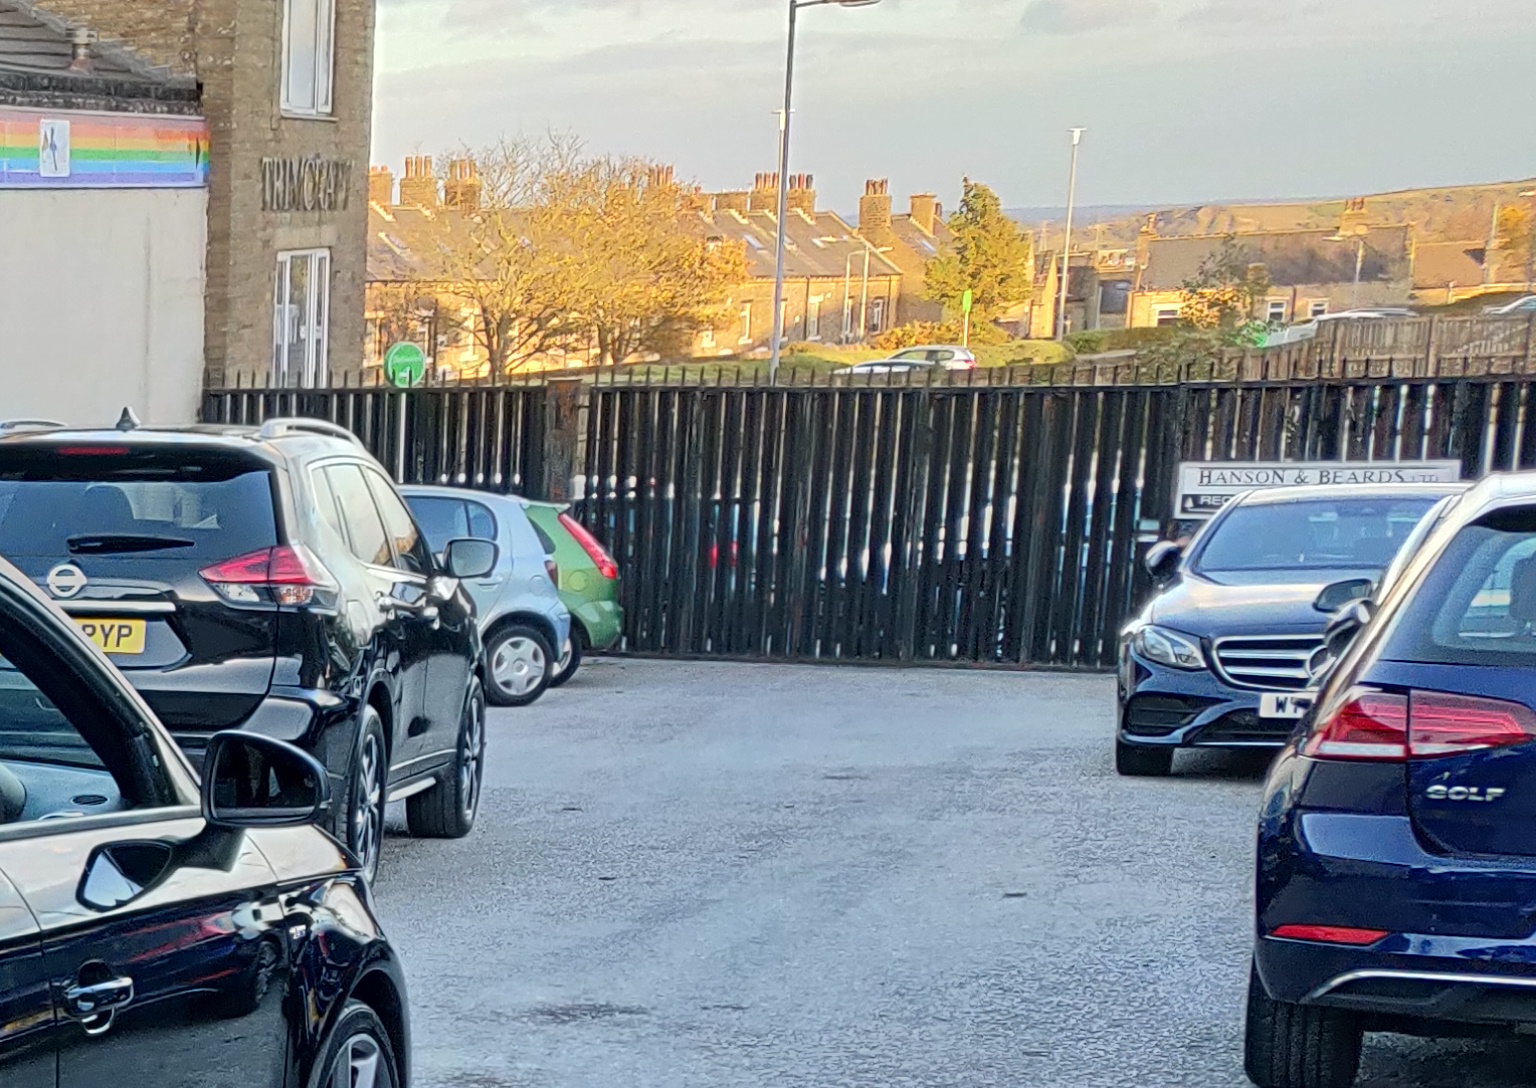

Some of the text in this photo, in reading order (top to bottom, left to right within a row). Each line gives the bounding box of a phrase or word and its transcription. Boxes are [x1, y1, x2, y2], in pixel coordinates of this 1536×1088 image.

[1199, 469, 1286, 485] HANSON
[1294, 470, 1310, 484] &
[1318, 469, 1405, 483] BEARDS
[1426, 784, 1506, 802] GOLF
